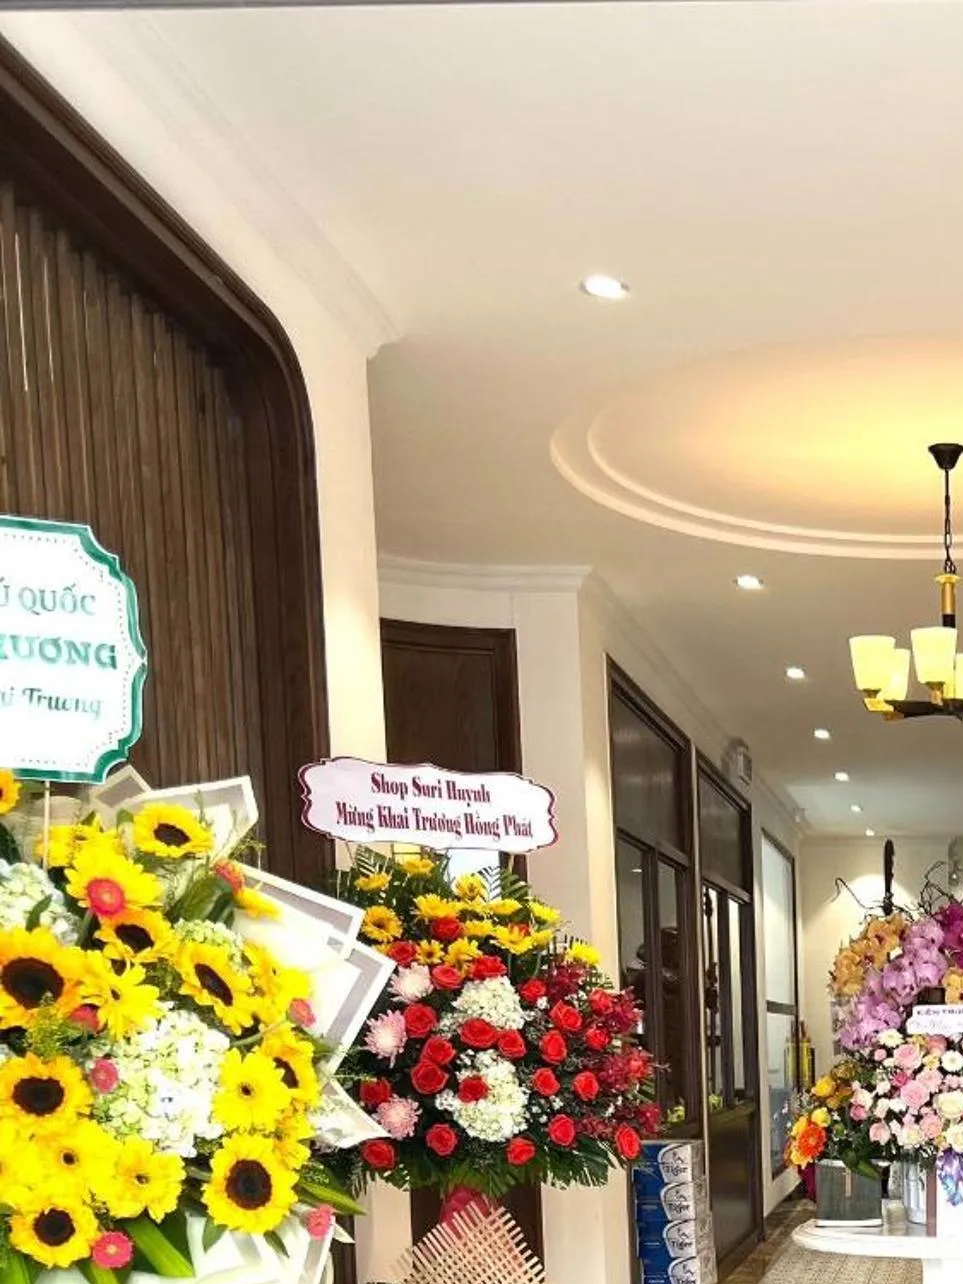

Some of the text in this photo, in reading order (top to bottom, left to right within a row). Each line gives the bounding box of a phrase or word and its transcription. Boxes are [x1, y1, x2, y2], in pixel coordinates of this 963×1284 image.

[18, 583, 97, 616] QUỐC
[370, 771, 409, 800] Shop
[411, 776, 443, 799] Suri
[377, 804, 410, 829] Khai
[671, 1240, 693, 1250] Tiger
